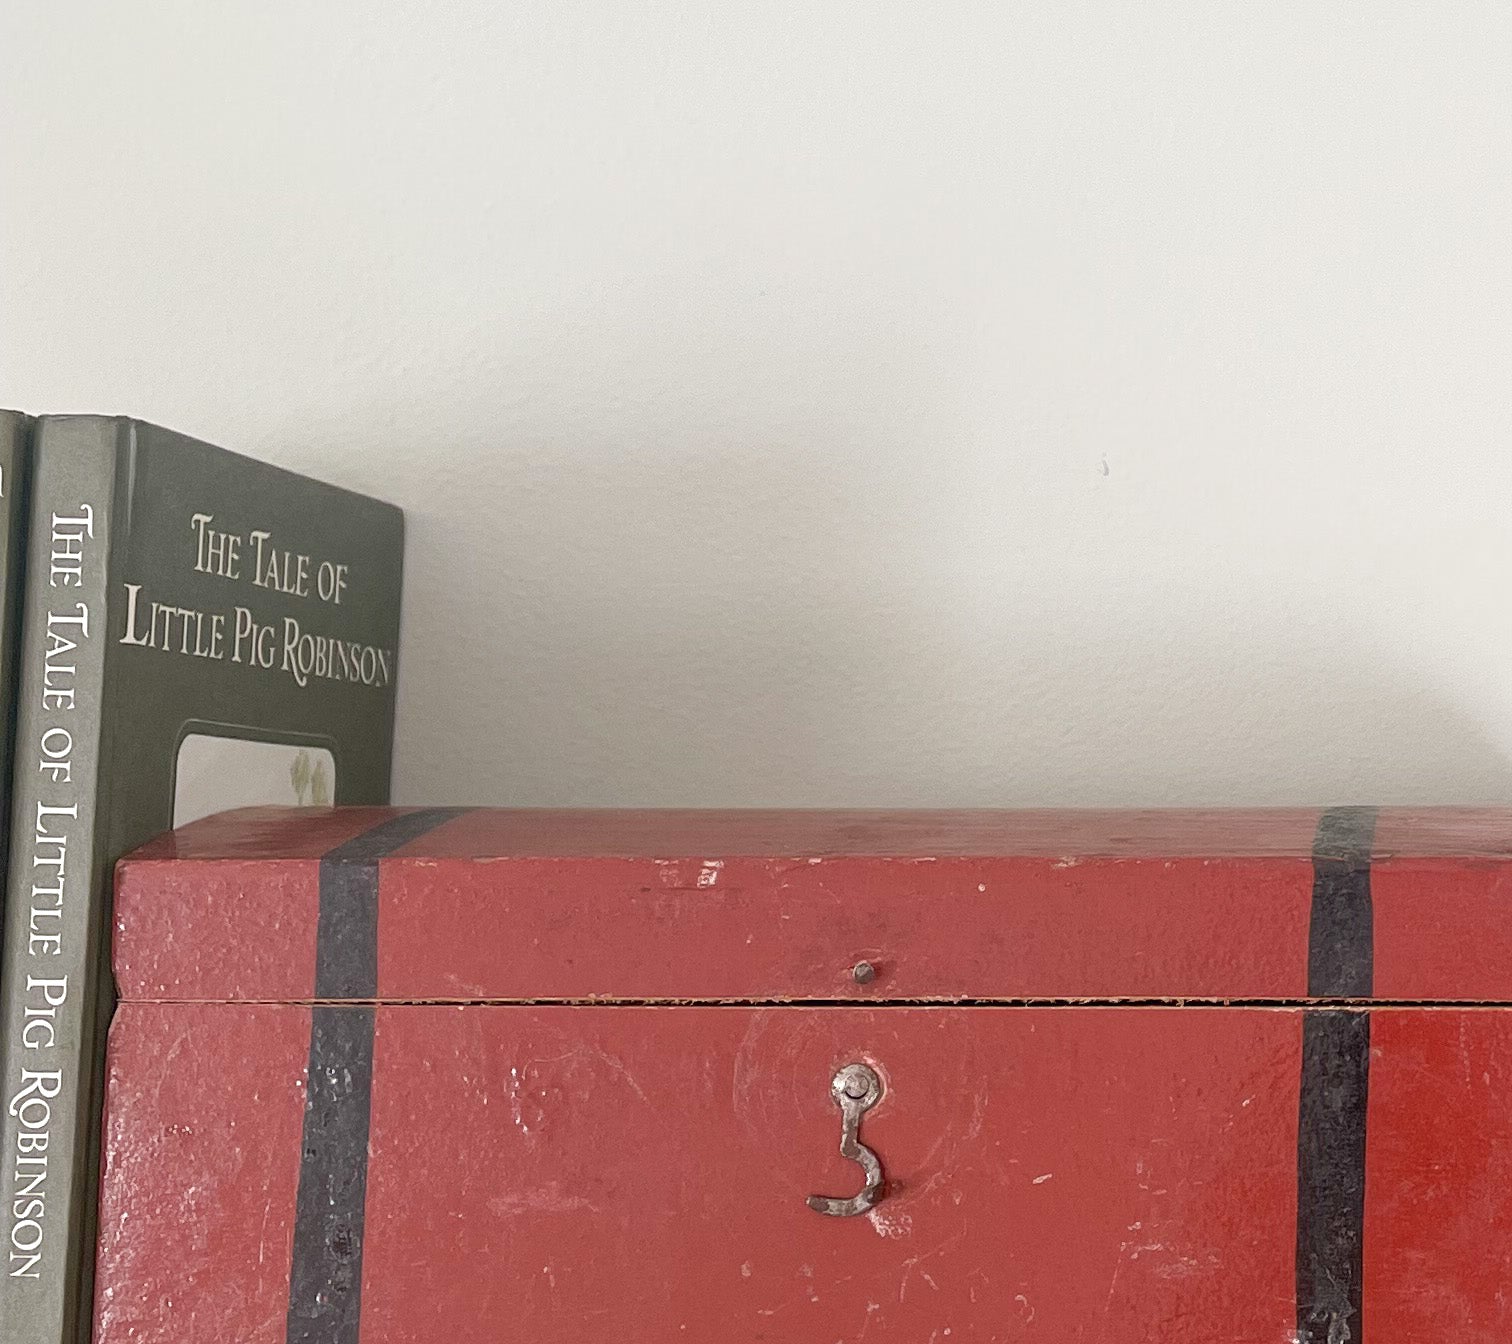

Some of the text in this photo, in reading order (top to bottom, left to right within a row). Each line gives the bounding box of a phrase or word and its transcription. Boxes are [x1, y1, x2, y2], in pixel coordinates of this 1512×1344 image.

[191, 513, 349, 605] THE TALE OF
[119, 583, 391, 688] LITTLE PIG ROBINSON
[9, 503, 94, 1280] THE TALE OF LITTLE PIG ROBINSON
